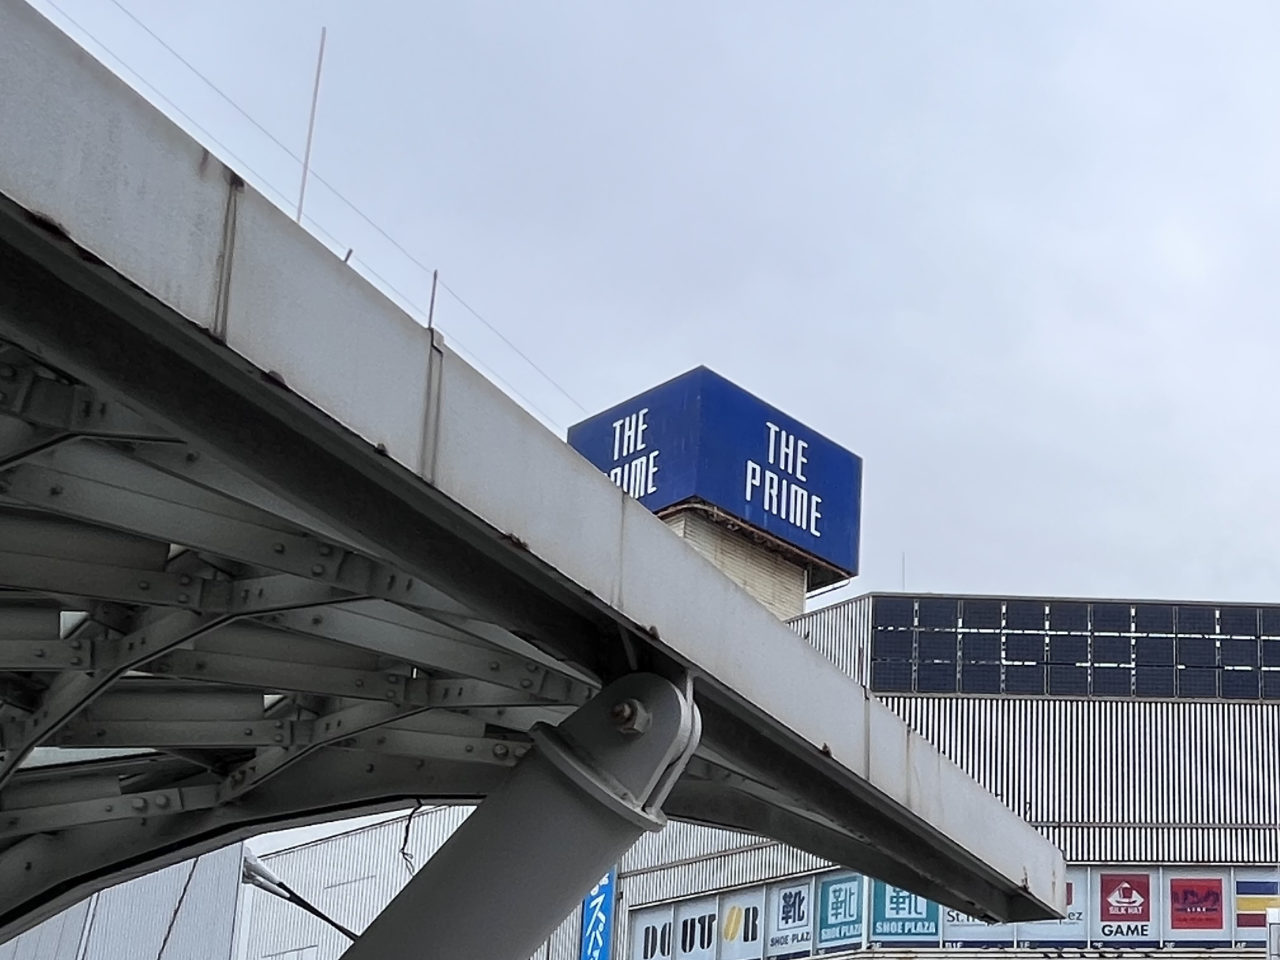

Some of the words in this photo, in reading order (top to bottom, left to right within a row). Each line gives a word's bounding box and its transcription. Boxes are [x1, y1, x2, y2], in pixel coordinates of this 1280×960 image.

[612, 407, 649, 461] THE
[766, 421, 808, 482] THE
[604, 450, 660, 500] IME
[745, 460, 822, 537] PRIME
[781, 890, 805, 925] 靴
[831, 887, 856, 920] 靴
[643, 905, 759, 960] DOUTOR
[770, 935, 789, 948] SHOE
[791, 932, 812, 944] PLAZ
[876, 921, 903, 934] SHOE
[904, 921, 936, 934] PLAZA
[1102, 925, 1149, 937] GAME
